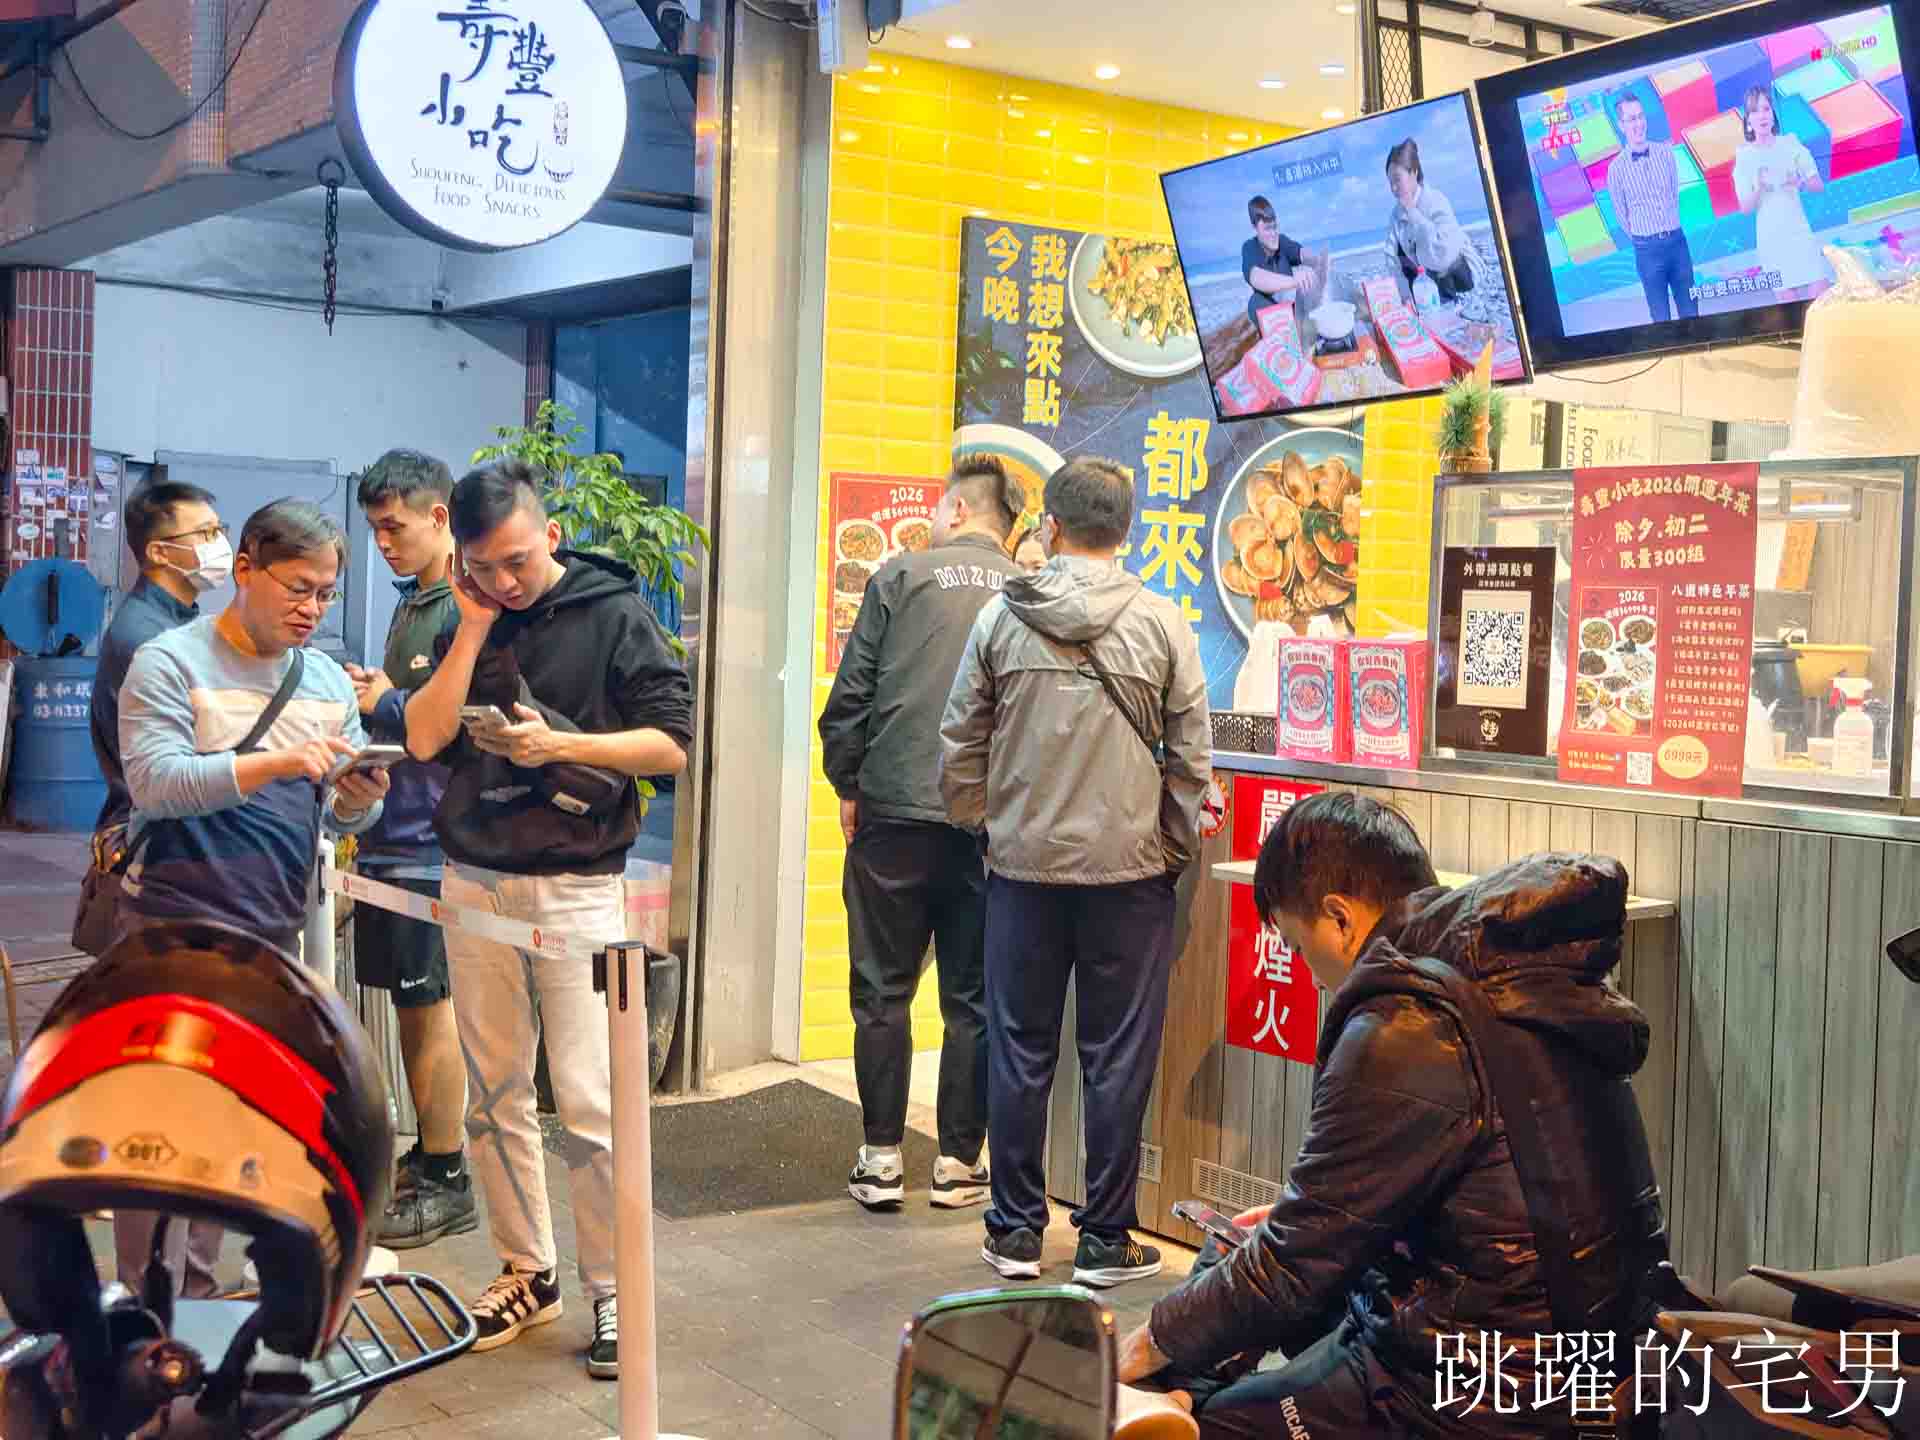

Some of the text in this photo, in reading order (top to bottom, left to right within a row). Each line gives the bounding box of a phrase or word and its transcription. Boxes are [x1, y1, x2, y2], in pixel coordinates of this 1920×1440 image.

[420, 72, 539, 176] 小吃
[983, 227, 1023, 325] 今晚
[1023, 234, 1068, 428] 我想來點
[889, 487, 924, 504] 2026
[1138, 411, 1210, 642] 都來
[1619, 544, 1705, 568] 限量300組
[934, 566, 1003, 590] MIZU
[1618, 590, 1645, 604] 2026
